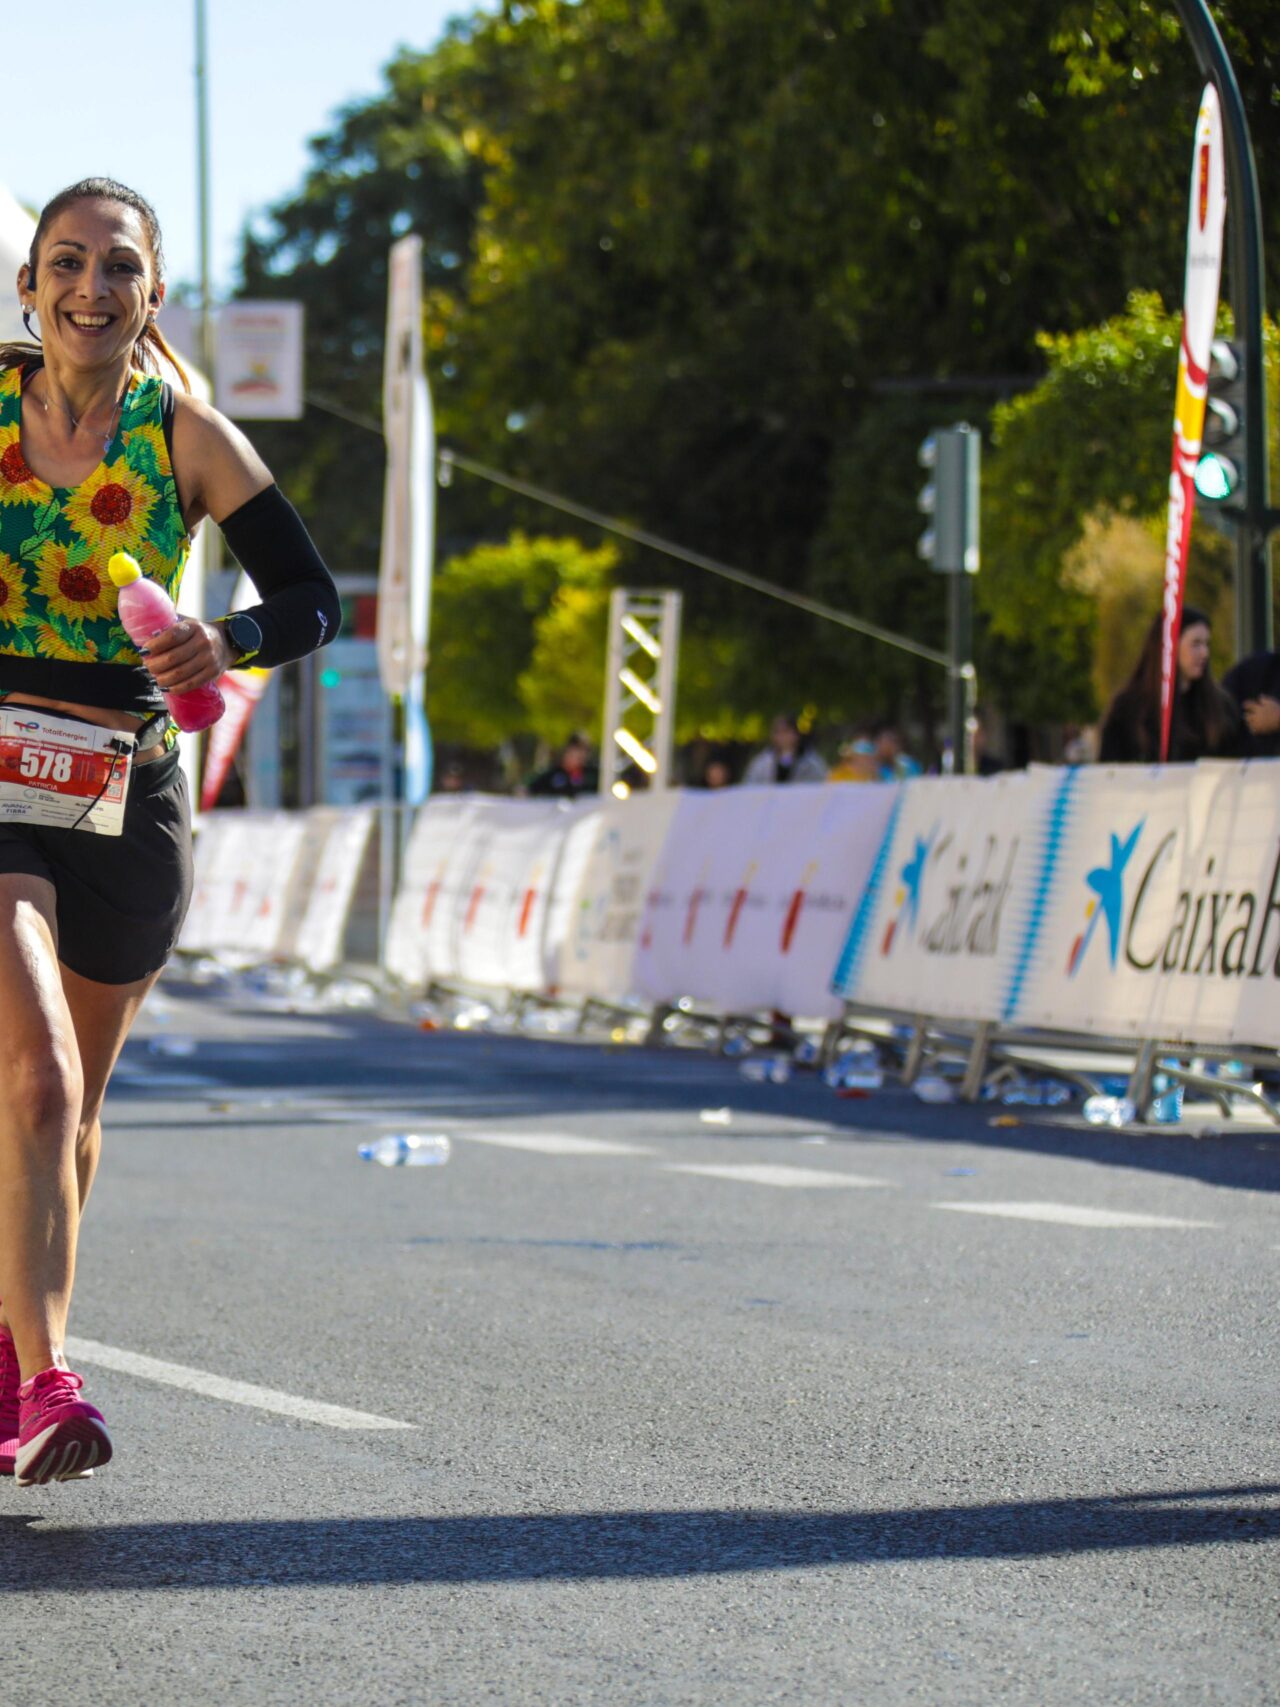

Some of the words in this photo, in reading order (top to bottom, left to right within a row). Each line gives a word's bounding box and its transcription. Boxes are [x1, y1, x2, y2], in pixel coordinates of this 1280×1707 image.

[42, 727, 88, 742] TotalEnergies
[21, 748, 73, 783] 578
[28, 780, 58, 792] PATRICIA
